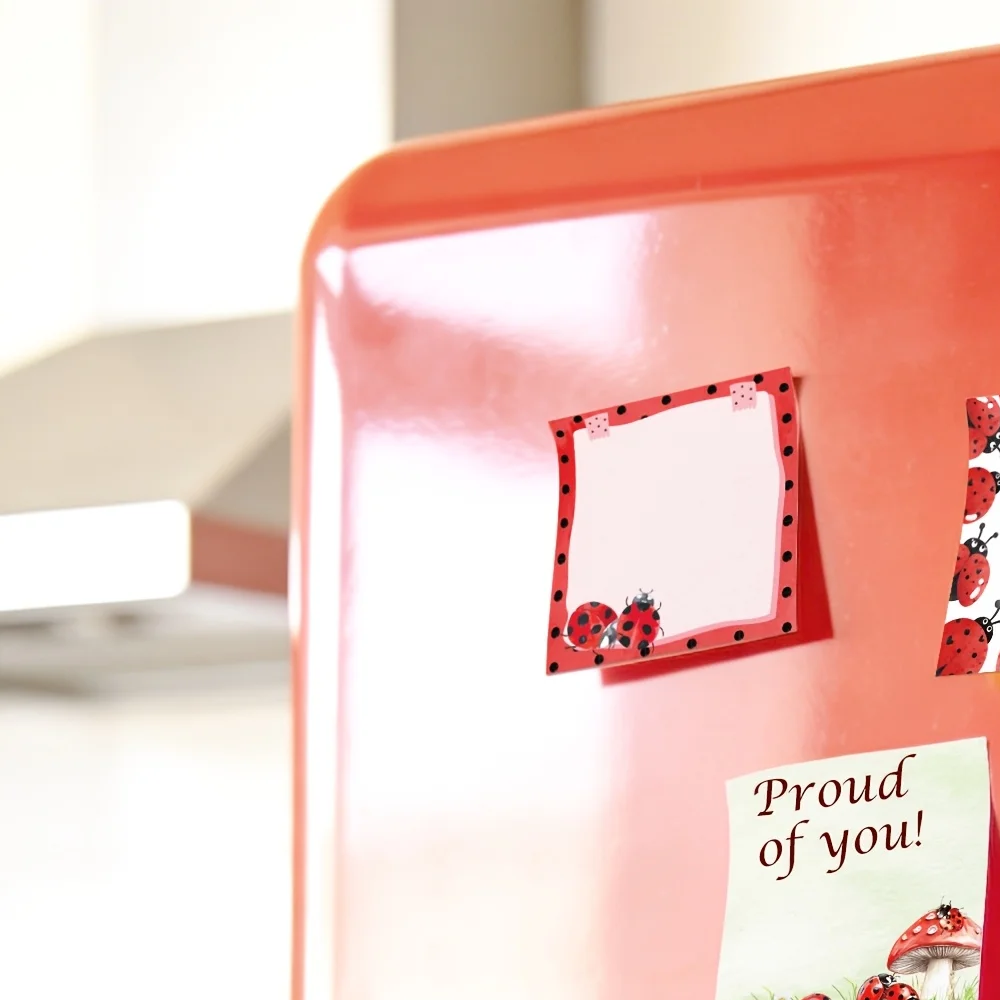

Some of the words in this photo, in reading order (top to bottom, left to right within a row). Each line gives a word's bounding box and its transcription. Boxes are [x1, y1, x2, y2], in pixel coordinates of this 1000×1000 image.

[753, 753, 917, 817] Proud
[759, 819, 811, 881] of
[818, 809, 924, 874] you!
